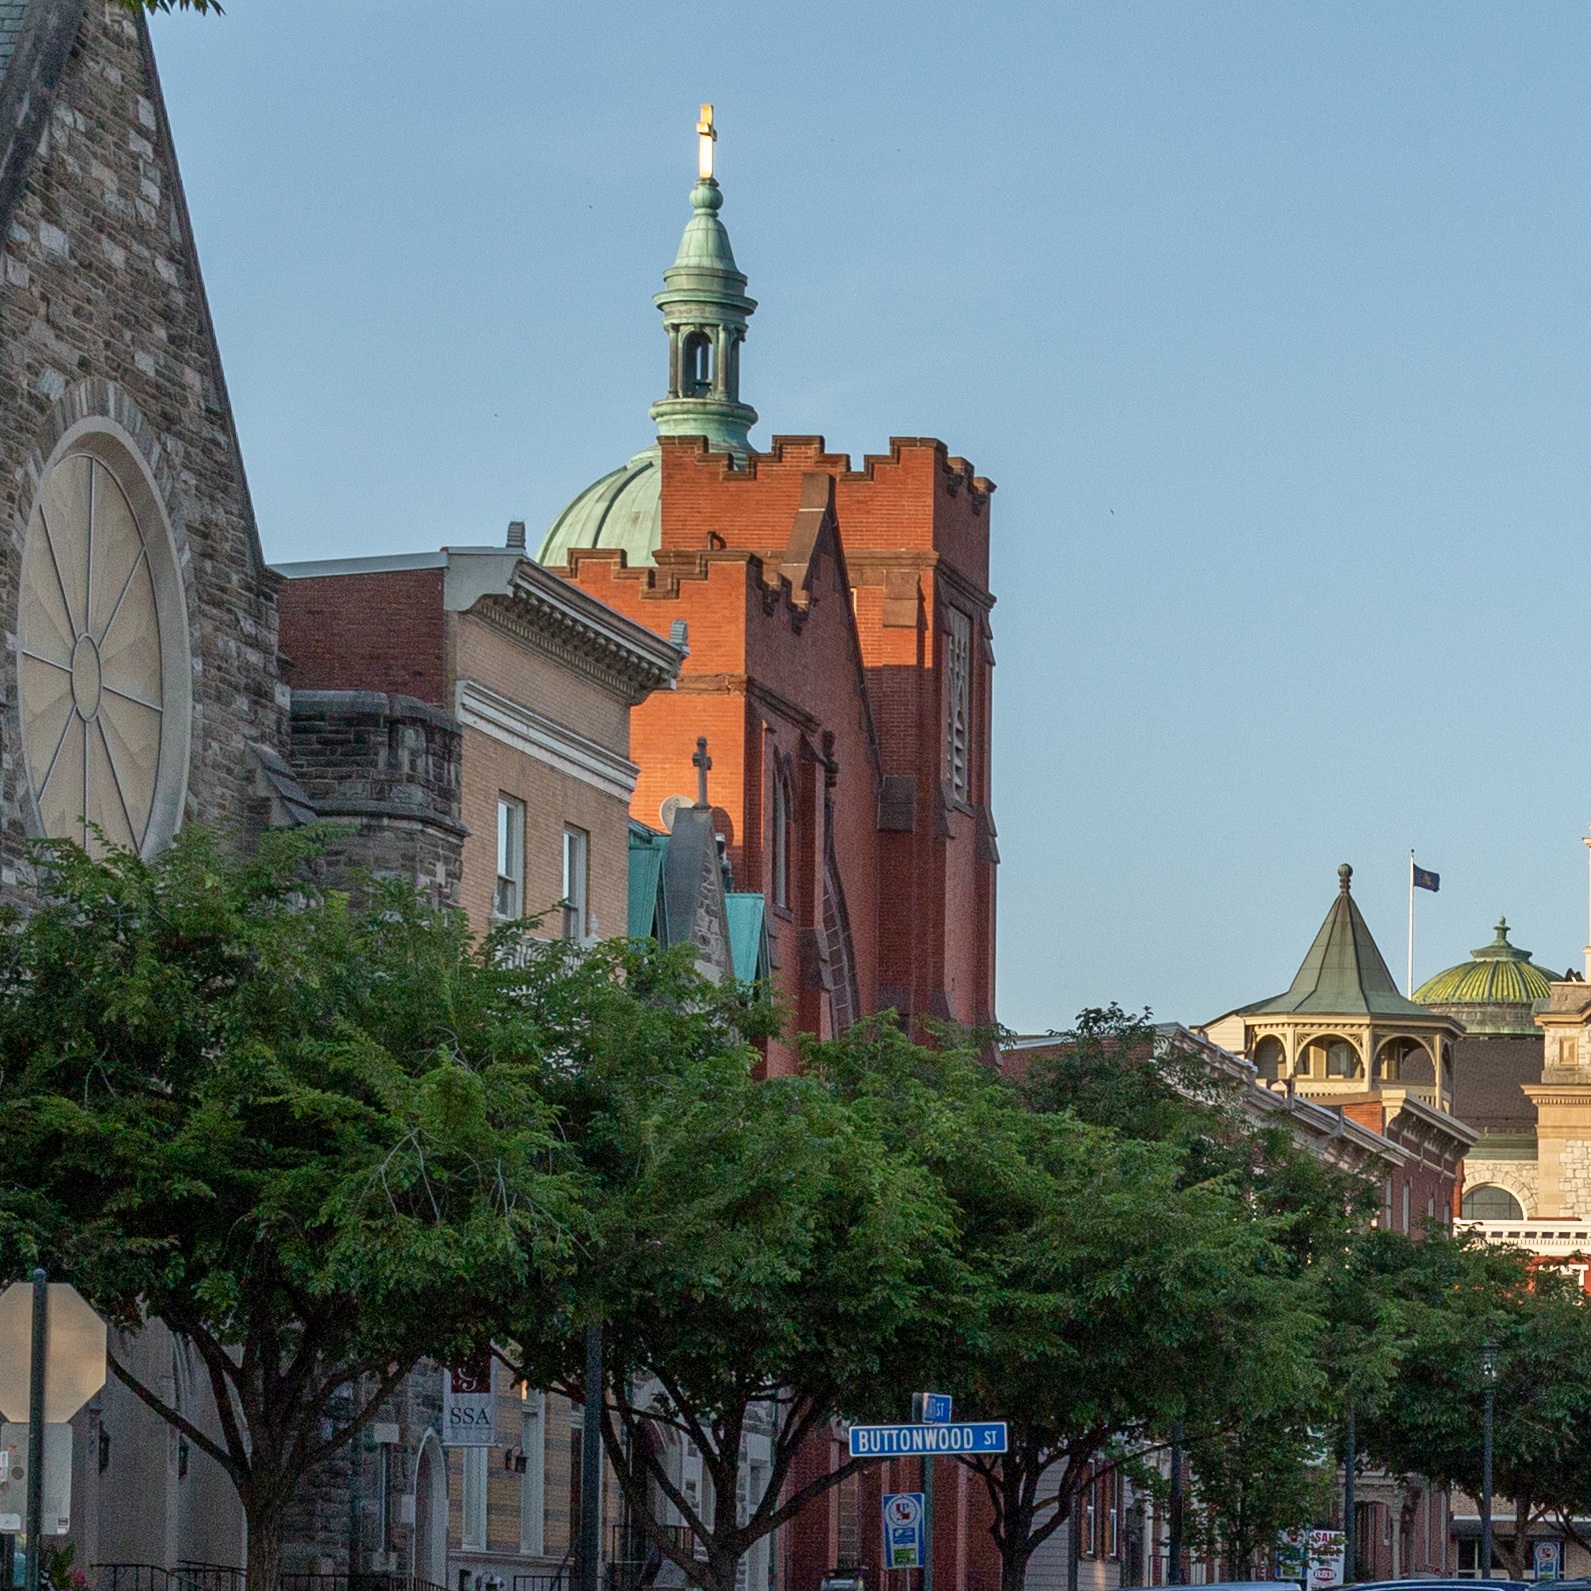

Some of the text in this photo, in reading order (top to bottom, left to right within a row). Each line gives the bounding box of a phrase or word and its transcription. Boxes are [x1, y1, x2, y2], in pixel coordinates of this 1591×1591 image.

[450, 1407, 491, 1425] SSA
[858, 1428, 997, 1452] BUTTONWOOD ST
